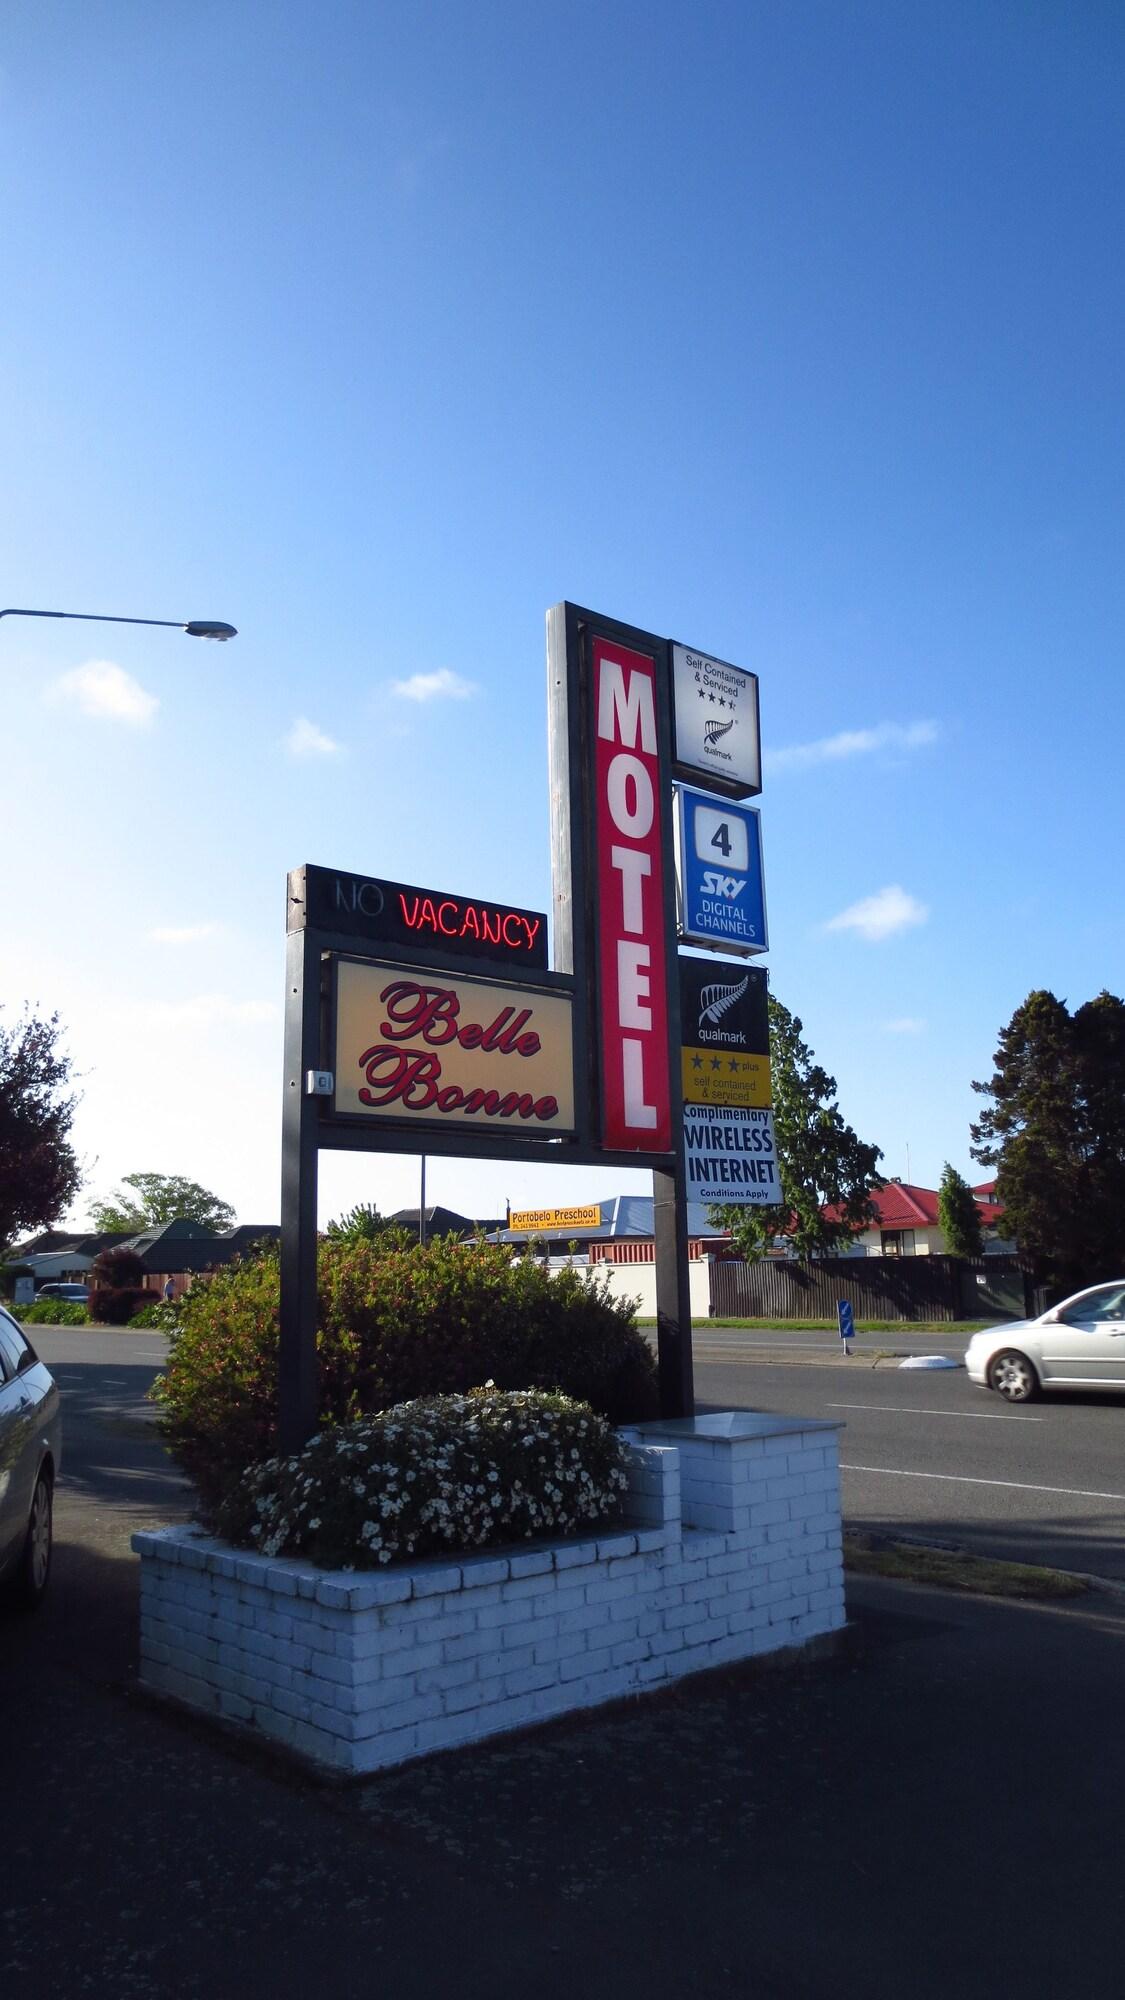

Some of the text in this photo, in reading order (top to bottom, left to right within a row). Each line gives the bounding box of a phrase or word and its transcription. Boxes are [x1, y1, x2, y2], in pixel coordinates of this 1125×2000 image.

[686, 655, 746, 688] Self Contained
[695, 674, 738, 697] & Serviced
[704, 745, 732, 761] qualmark
[711, 823, 732, 857] 4
[598, 658, 658, 1130] MOTEL
[700, 871, 747, 899] SKY
[336, 878, 539, 949] NO VACANCY
[702, 900, 747, 922] DIGITAL
[696, 913, 755, 937] CHANNELS
[380, 981, 541, 1057] Belle
[698, 1029, 746, 1044] qualmark
[743, 1063, 760, 1071] plus
[358, 1044, 559, 1120] Bonne
[713, 1080, 756, 1090] contained
[703, 1087, 749, 1101] & serviced
[683, 1104, 768, 1126] Complimentary
[684, 1124, 772, 1152] WIRELESS
[689, 1157, 774, 1183] INTERNET
[701, 1189, 768, 1199] Conditions Apply
[513, 1208, 596, 1222] Portobelo Preschool
